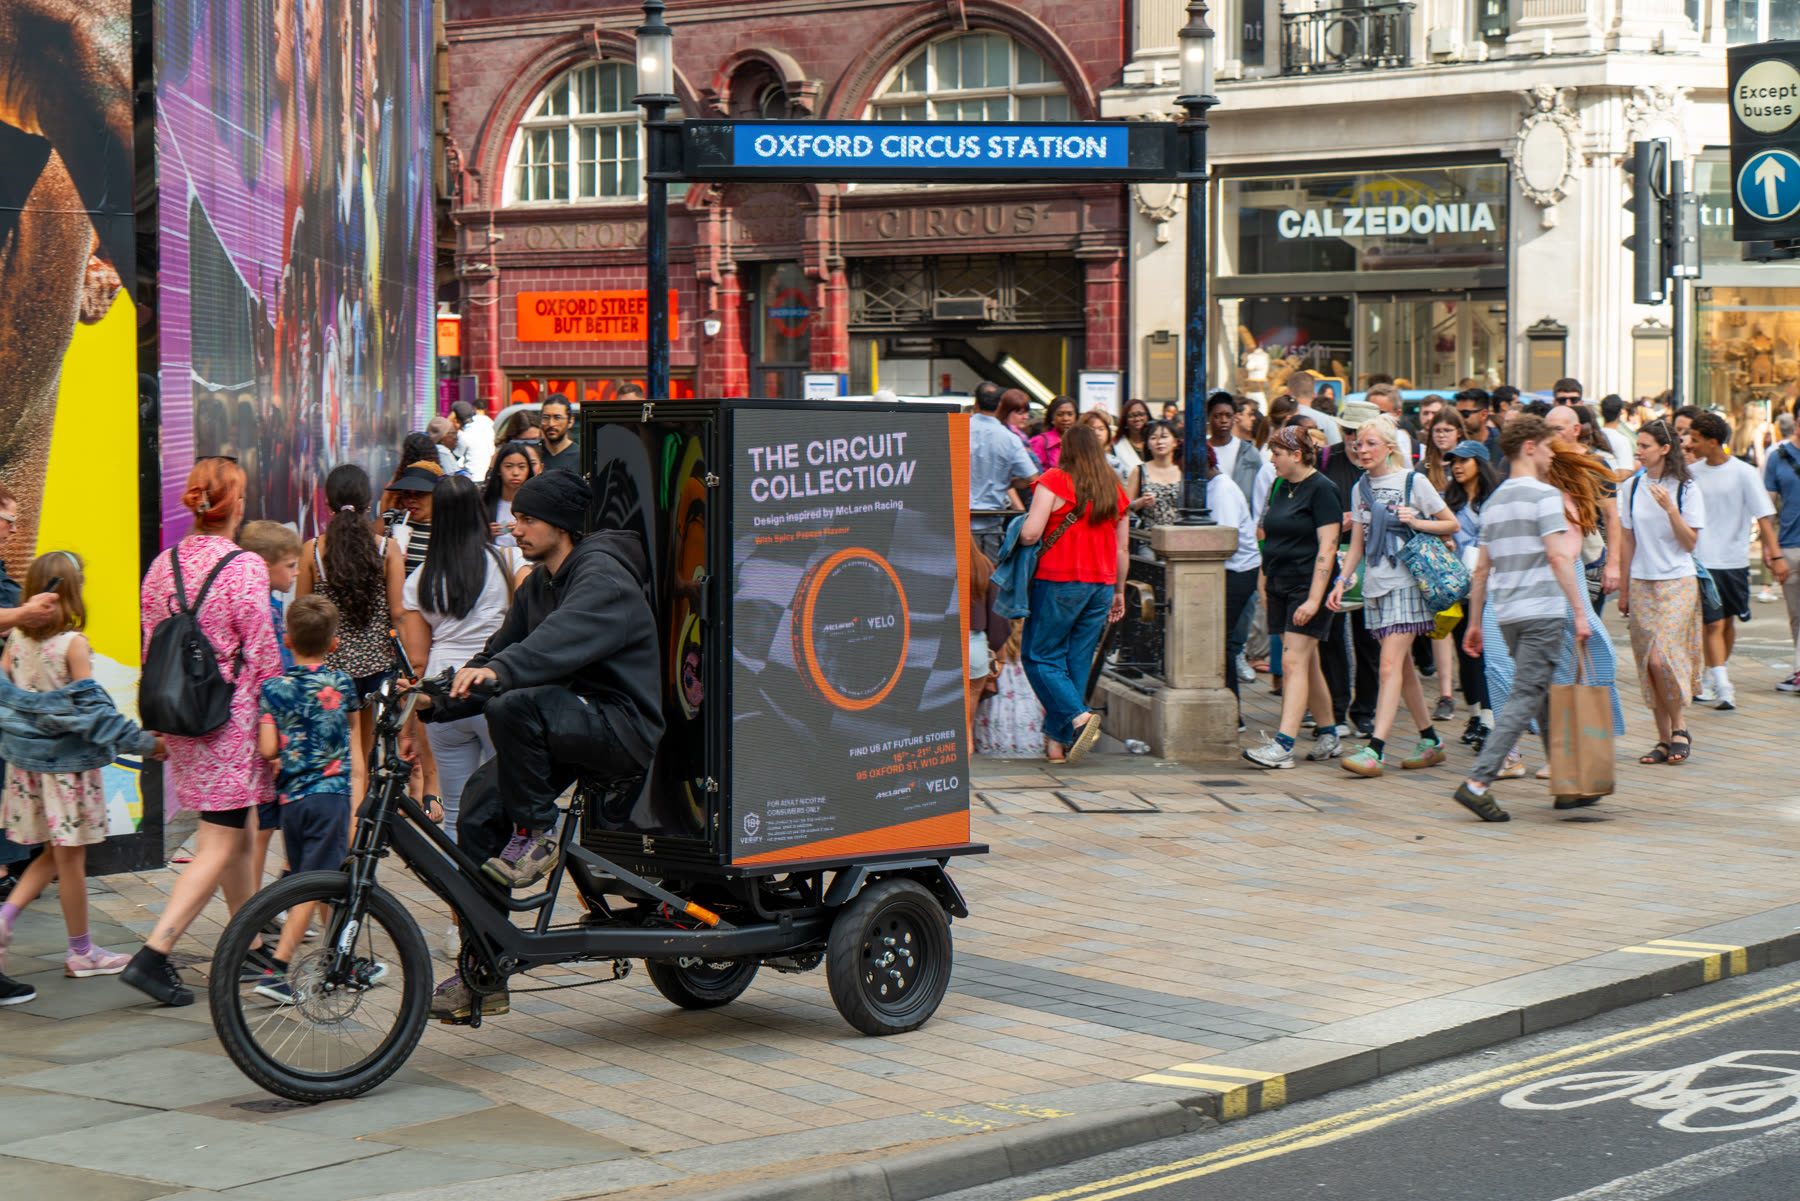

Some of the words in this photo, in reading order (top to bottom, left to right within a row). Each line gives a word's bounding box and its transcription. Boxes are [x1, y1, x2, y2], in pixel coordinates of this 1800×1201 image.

[1740, 84, 1798, 100] Except
[1743, 104, 1793, 118] buses
[754, 134, 873, 158] OXFORD
[880, 135, 981, 159] CIRCUS
[987, 135, 1107, 159] STATION
[878, 204, 1038, 239] CIRCUS
[1277, 202, 1496, 239] CALZEDONIA
[525, 222, 643, 250] OXFOR
[535, 298, 598, 316] OXFORD
[554, 317, 582, 334] BUT
[585, 316, 639, 334] BETTER
[748, 443, 800, 472] THE
[806, 432, 908, 466] CIRCUIT
[750, 460, 917, 502] COLLECTION
[753, 514, 785, 527] Design
[786, 507, 822, 523] inspired
[823, 507, 834, 520] by
[835, 503, 873, 516] McLaren
[874, 500, 904, 512] Racing
[755, 536, 773, 545] With
[867, 614, 895, 629] VELO
[849, 747, 868, 757] FIND
[870, 744, 880, 754] US
[882, 741, 892, 751] AT
[893, 735, 923, 749] FUTURE
[925, 729, 956, 743] STORES
[934, 742, 956, 754] JUNE
[856, 770, 868, 781] 95
[869, 763, 905, 778] OXFORD
[940, 753, 957, 765] 2AD
[926, 776, 959, 793] VELO
